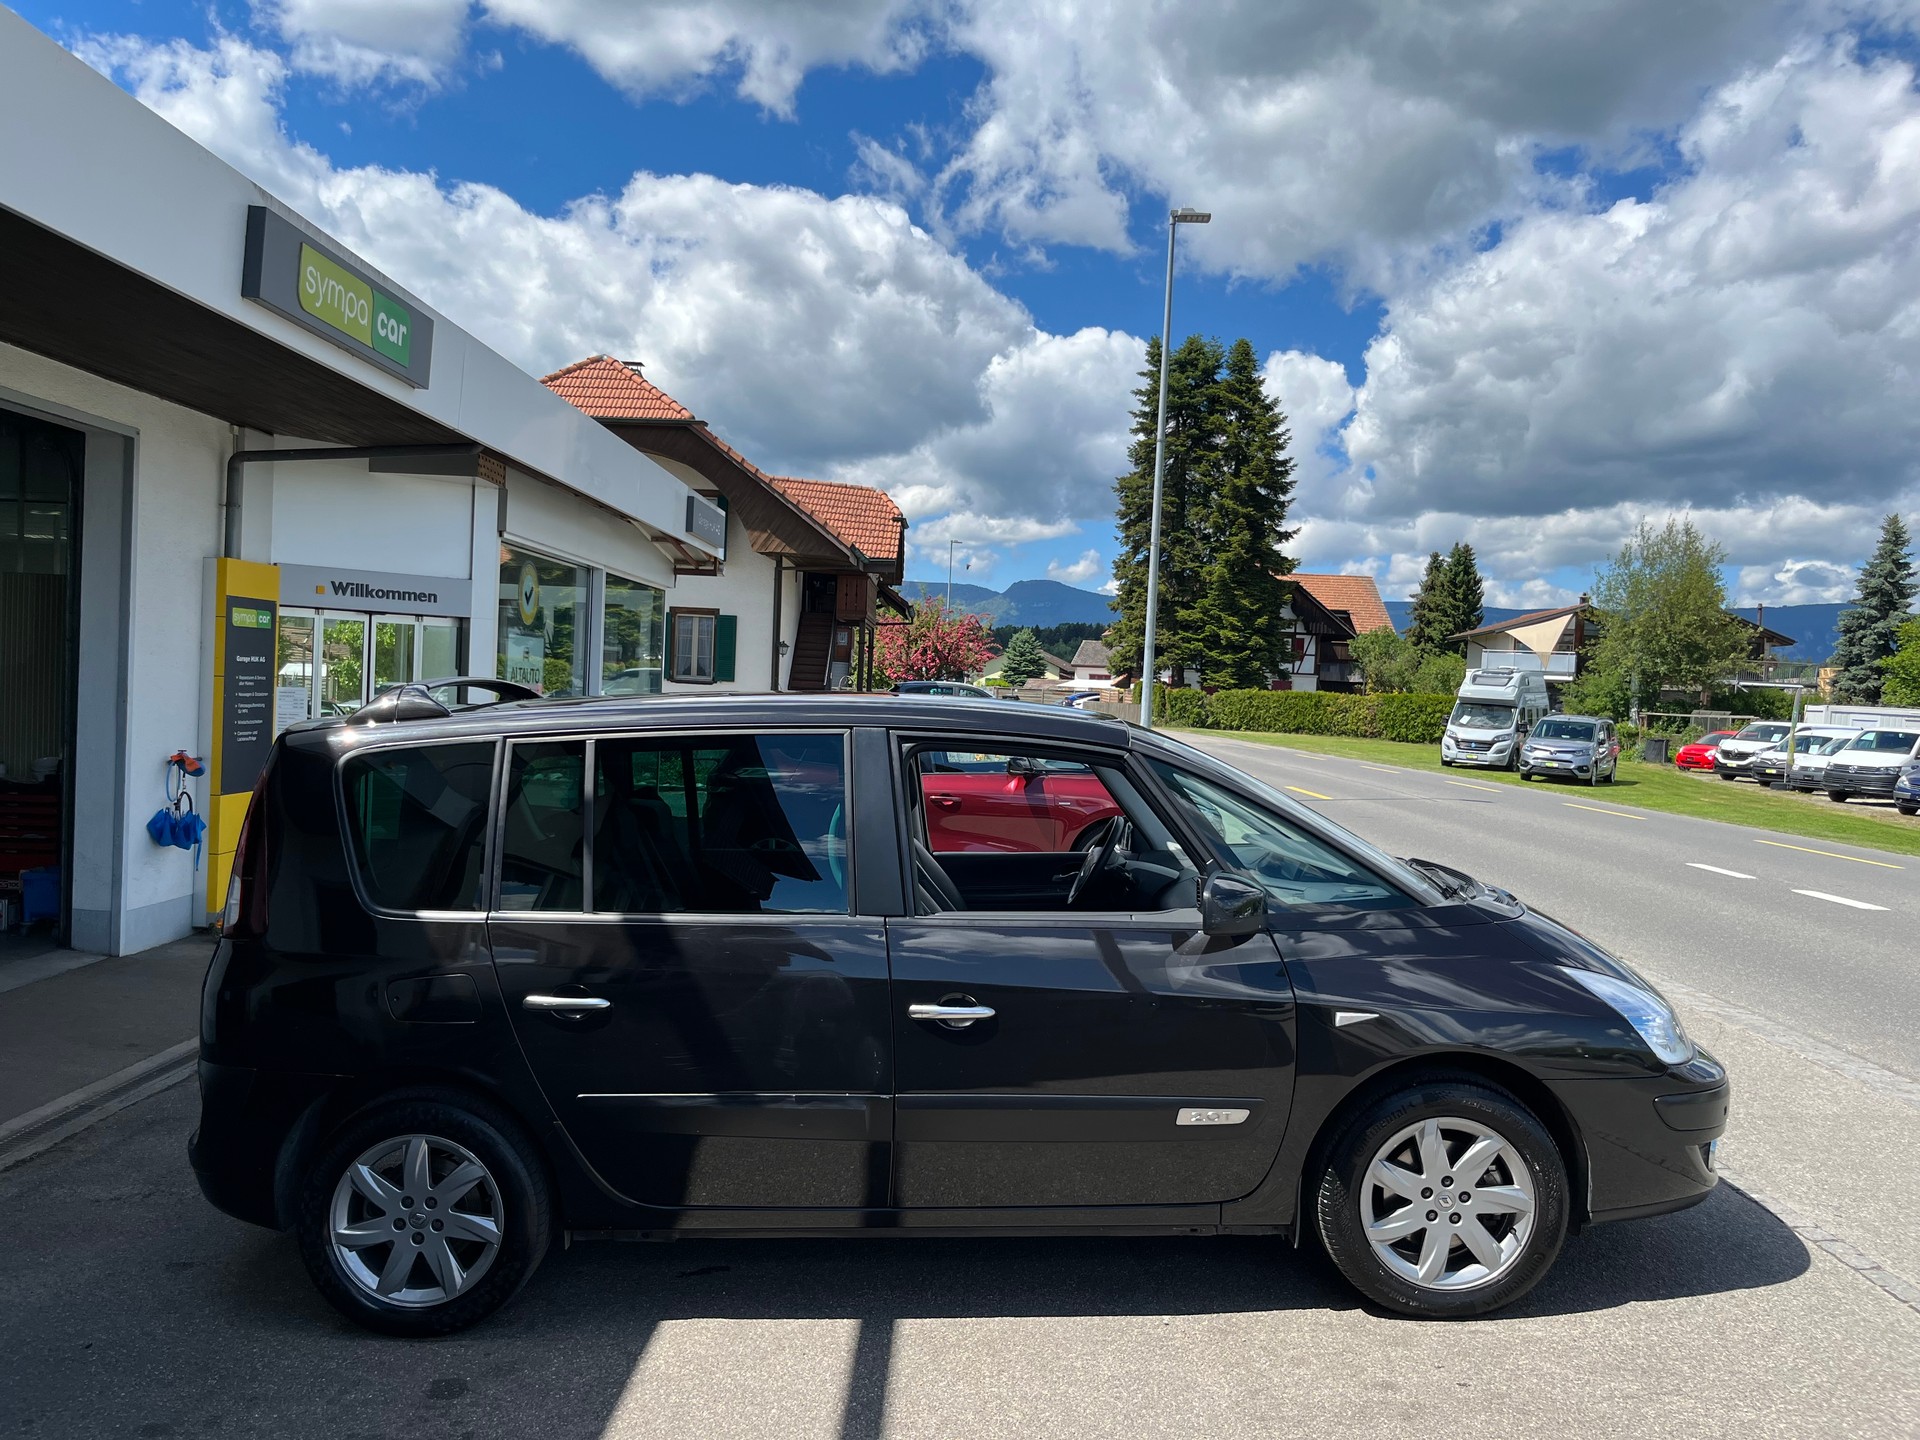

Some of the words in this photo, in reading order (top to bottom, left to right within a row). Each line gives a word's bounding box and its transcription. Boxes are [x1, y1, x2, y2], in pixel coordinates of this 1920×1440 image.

[305, 266, 369, 326] sympa
[377, 311, 408, 347] car
[331, 581, 438, 603] Willkommen
[234, 613, 256, 624] sympa
[258, 615, 270, 623] car
[236, 655, 251, 663] Garage
[511, 666, 540, 684] ALTAUTO
